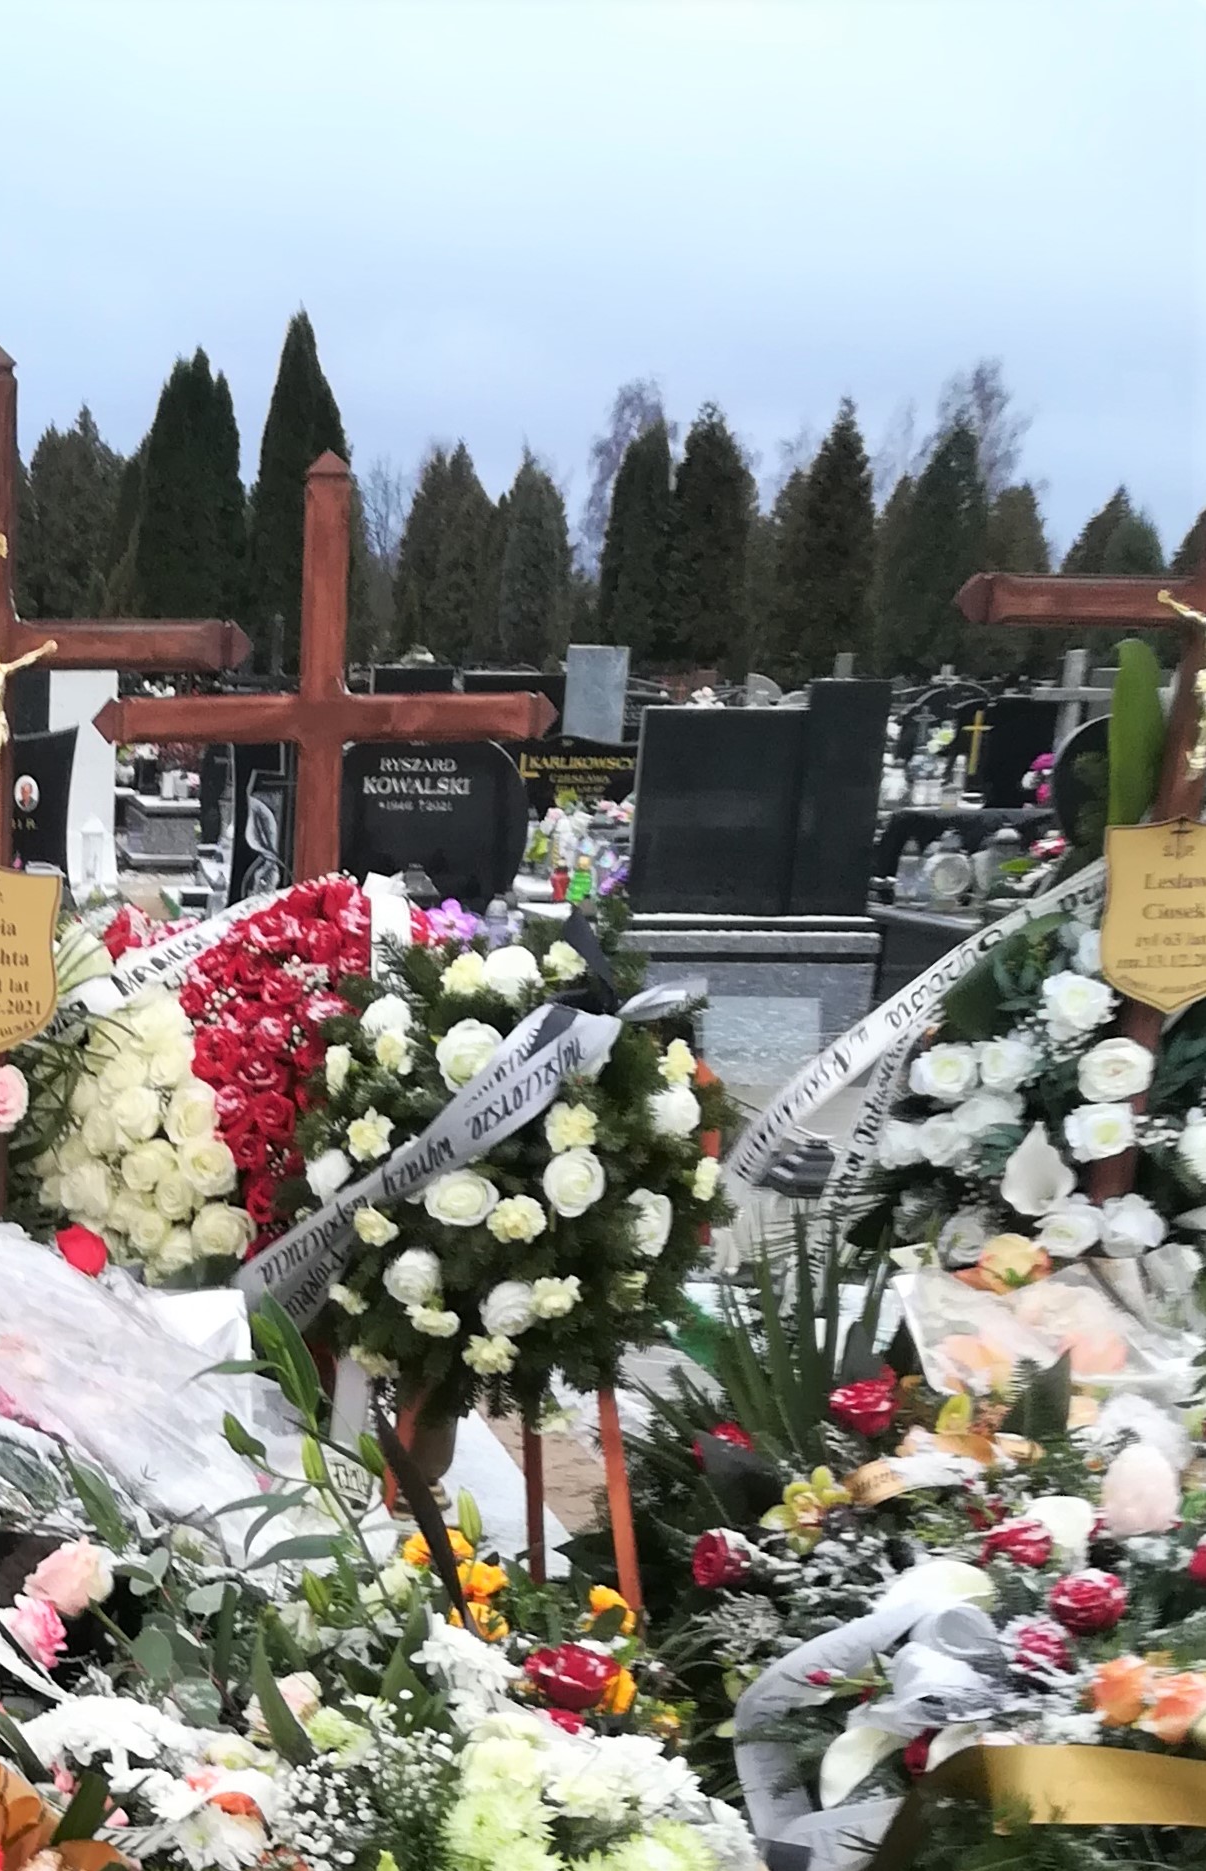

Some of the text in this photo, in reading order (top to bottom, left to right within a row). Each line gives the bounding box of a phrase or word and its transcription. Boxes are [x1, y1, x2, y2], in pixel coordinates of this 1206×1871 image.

[379, 757, 458, 772] RYSZARD
[362, 776, 471, 795] KOWALSKI
[9, 978, 30, 993] lat
[381, 1135, 456, 1197] wyrazy
